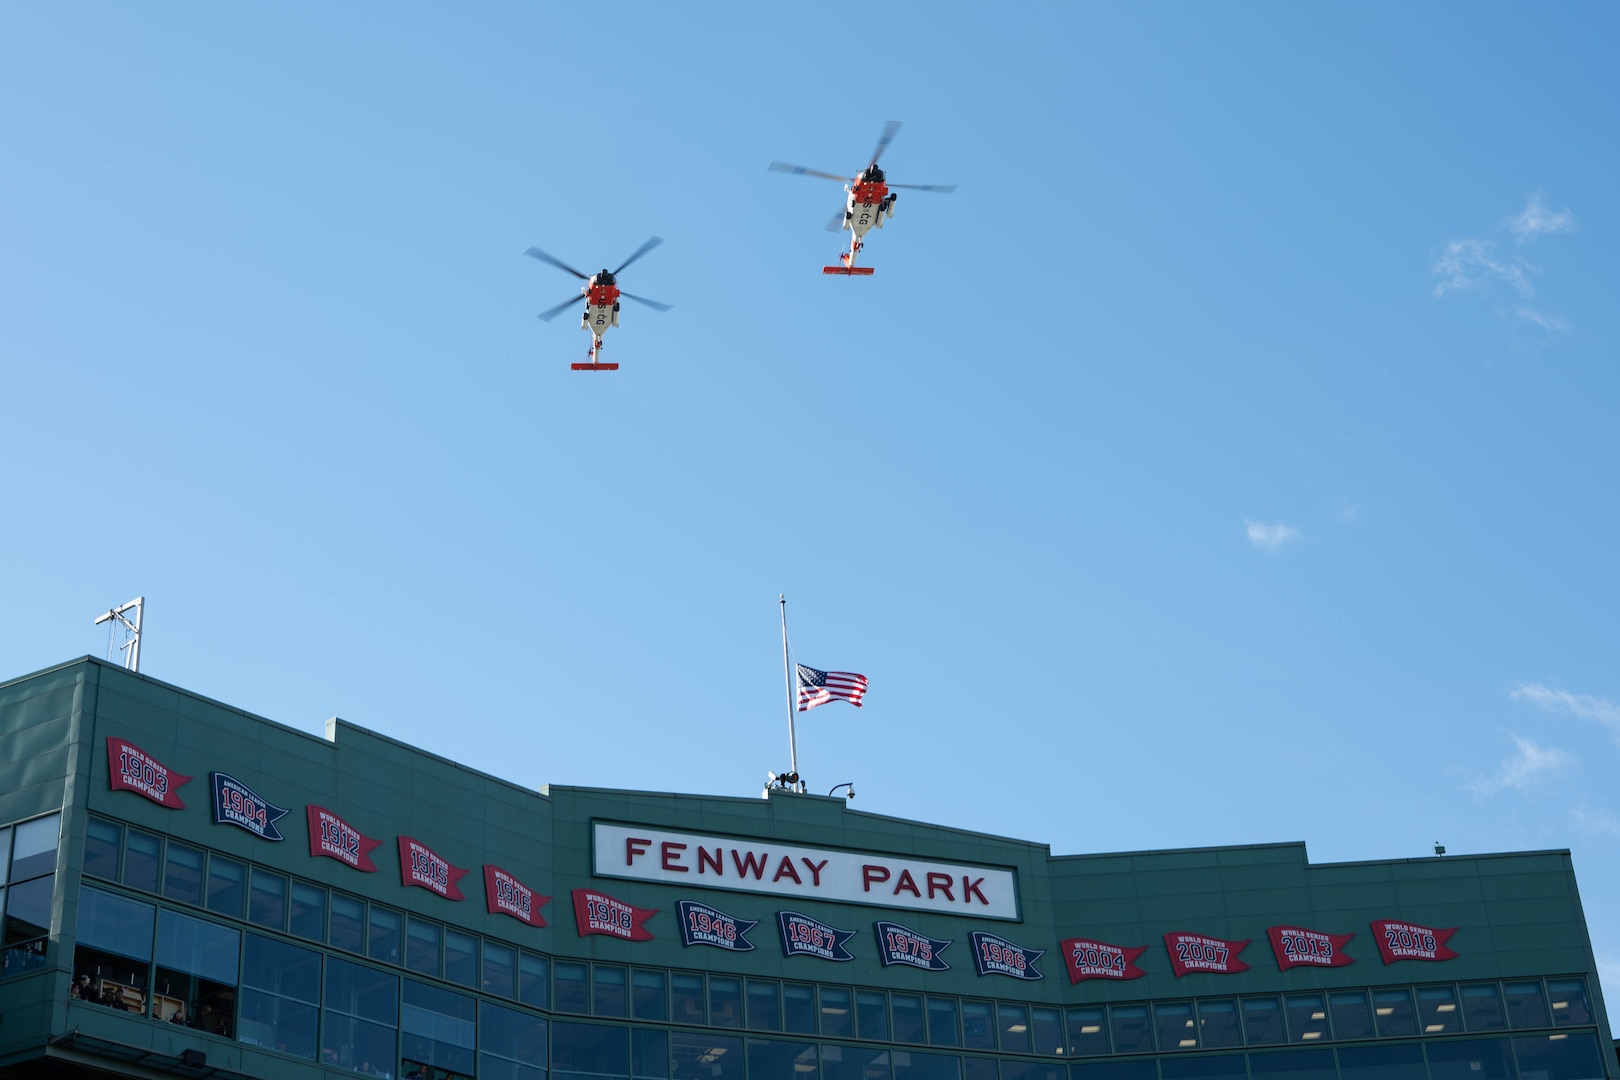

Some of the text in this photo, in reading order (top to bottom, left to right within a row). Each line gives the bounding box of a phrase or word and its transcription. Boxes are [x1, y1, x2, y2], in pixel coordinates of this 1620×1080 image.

[121, 745, 168, 776] WORLD SERIES
[120, 754, 168, 795] 1903
[123, 775, 164, 802] CHAMPIONS
[224, 780, 266, 809] AMERICAN LEAGUE
[222, 788, 267, 828] 1904
[225, 809, 264, 834] CHAMPIONS
[320, 812, 360, 840] WORLD SERIES
[320, 820, 359, 857] 1912
[321, 841, 358, 866] CHAMPIONS
[410, 842, 448, 869] WORLD SERIES
[411, 851, 448, 886] 1915
[626, 837, 990, 906] FENWAY PARK
[412, 872, 447, 895] CHAMPIONS
[495, 871, 531, 897] WORLD SERIES
[496, 879, 531, 914] 1916
[586, 893, 632, 914] WORLD SERIES
[497, 899, 531, 921] CHAMPIONS
[588, 901, 632, 930] 1918
[690, 906, 734, 924] AMERICAN LEAGUE
[589, 920, 631, 938] CHAMPIONS
[689, 911, 737, 941] 1946
[789, 916, 833, 934] AMERICAN LEAGUE
[886, 927, 929, 945] AMERICAN LEAGUE
[1410, 926, 1433, 935] SERIES
[693, 932, 735, 948] CHAMPIONS
[789, 922, 836, 951] 1967
[886, 932, 932, 961] 1975
[981, 936, 1023, 954] AMERICAN LEAGUE
[1202, 938, 1225, 948] SERIES
[1282, 937, 1333, 957] 2013
[1306, 932, 1329, 941] SERIES
[1385, 930, 1436, 952] 2018
[794, 942, 834, 958] CHAMPIONS
[981, 942, 1026, 970] 1986
[1074, 942, 1122, 954] WORLD SERIES
[1176, 943, 1229, 964] 2007
[1393, 948, 1435, 958] CHAMPIONS
[892, 951, 930, 968] CHAMPIONS
[986, 961, 1024, 977] CHAMPIONS
[1073, 950, 1126, 971] 2004
[1185, 961, 1227, 971] CHAMPIONS
[1289, 955, 1331, 964] CHAMPIONS
[1081, 967, 1123, 977] CHAMPIONS
